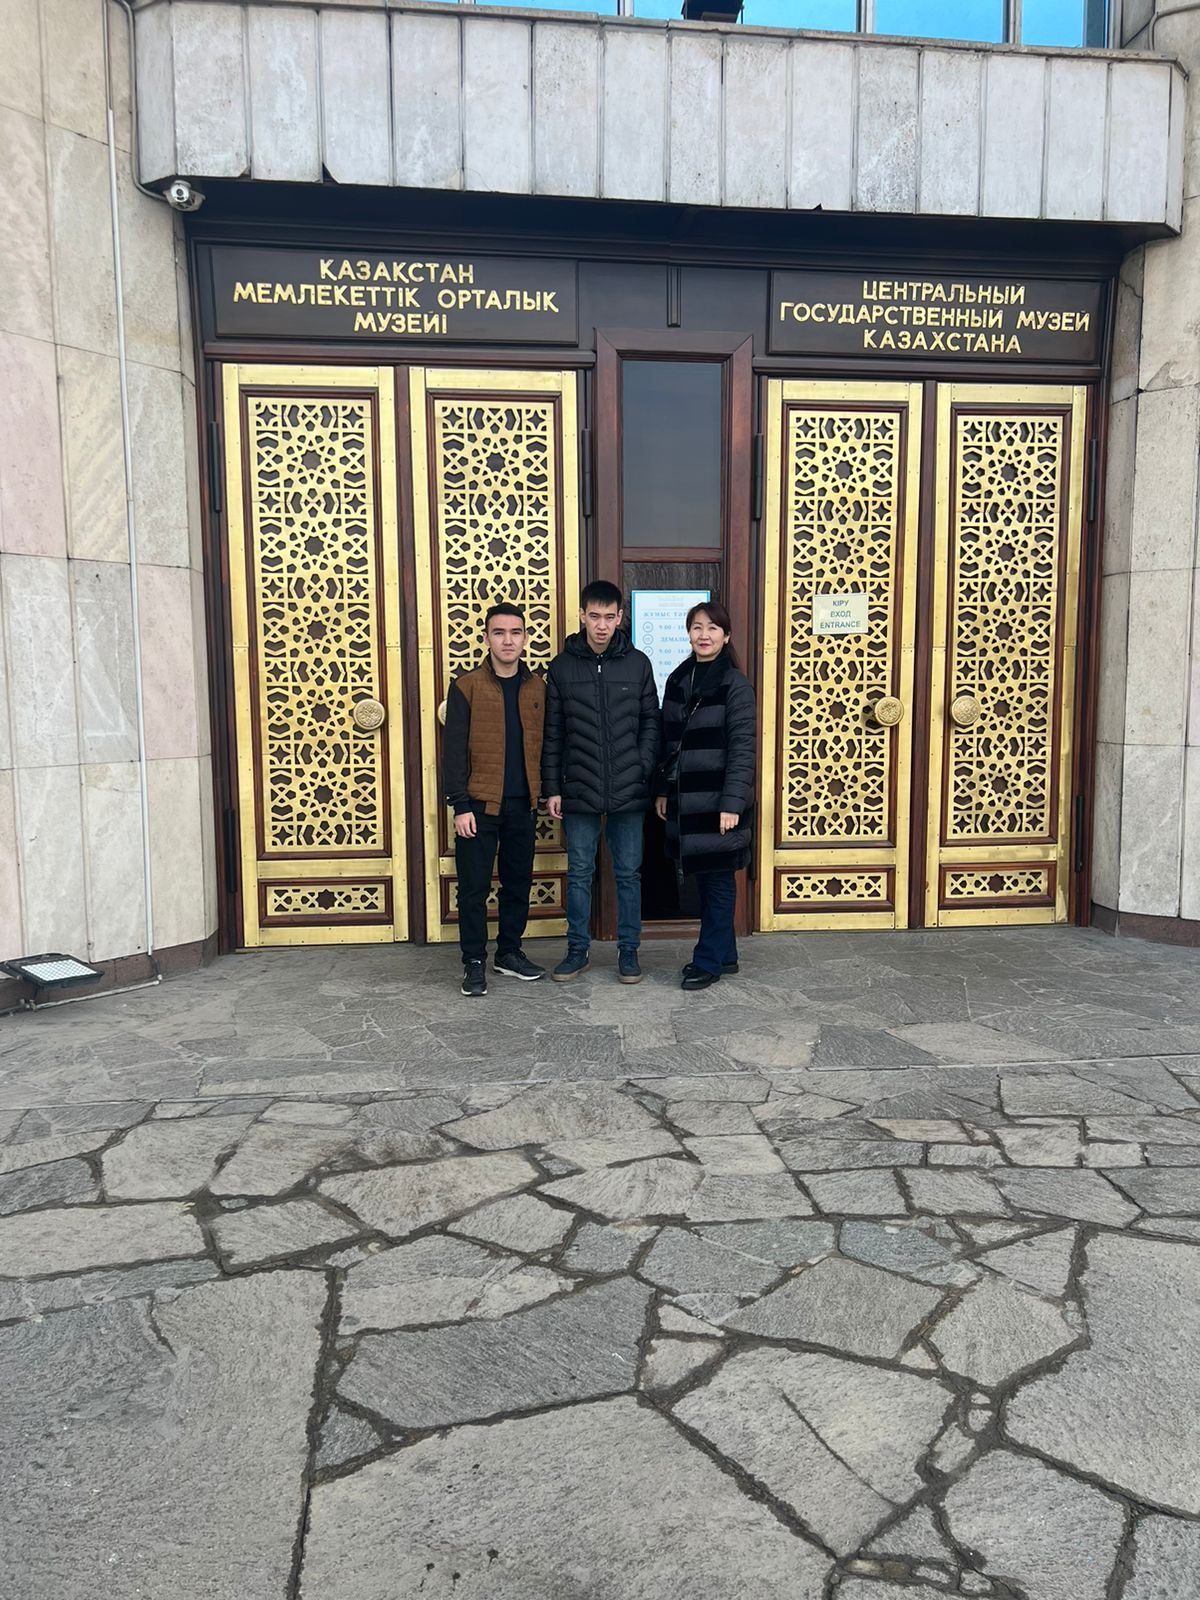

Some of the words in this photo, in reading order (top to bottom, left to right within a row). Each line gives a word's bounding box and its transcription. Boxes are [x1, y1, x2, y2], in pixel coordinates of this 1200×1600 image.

[233, 281, 421, 308] МЕМЛЕКЕТТІК
[862, 280, 1026, 305] ЦЕНТРАЛЬНЫЙ
[353, 310, 448, 335] МУЗЕЙІ
[780, 301, 1004, 329] ГОСУДАРСТВЕННЫЙ
[1015, 308, 1090, 332] МУЗЕЙ
[863, 328, 1022, 354] КАЗАХСТАНА
[820, 620, 861, 629] ENTRANCE
[830, 610, 851, 618] ВХОД
